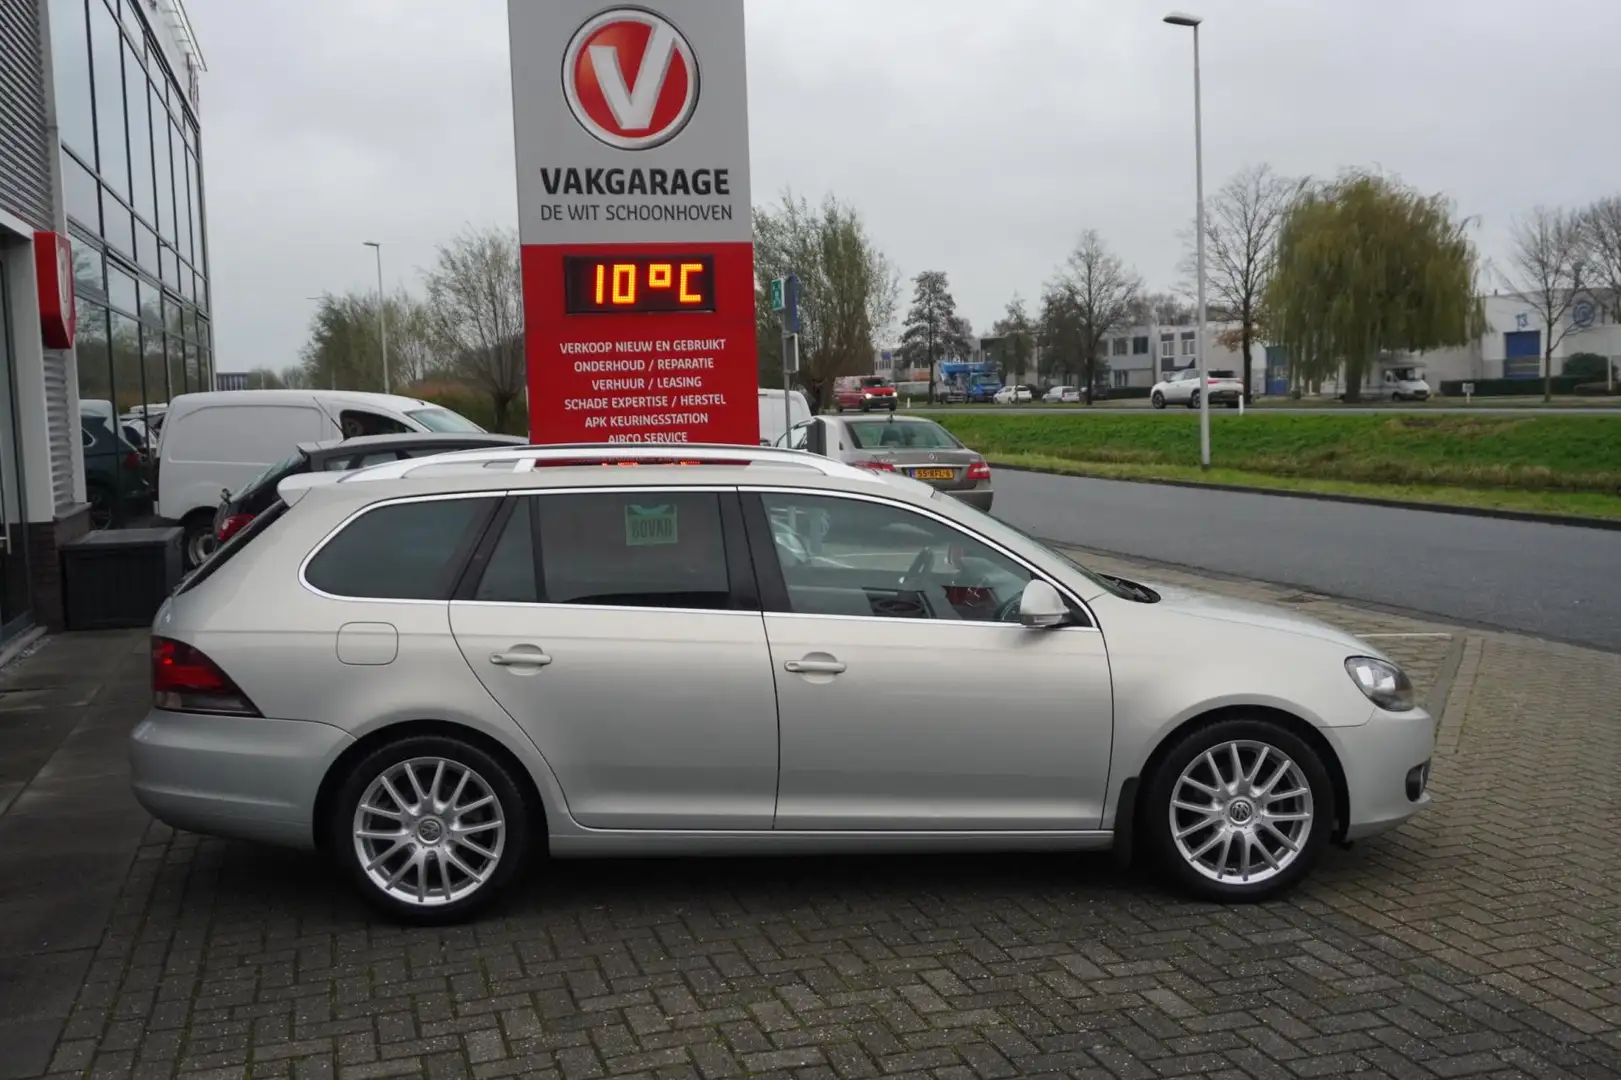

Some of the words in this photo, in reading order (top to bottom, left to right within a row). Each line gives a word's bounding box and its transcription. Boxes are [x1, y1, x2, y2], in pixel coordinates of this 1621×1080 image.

[540, 167, 730, 195] VAKGARAGE
[540, 204, 563, 221] DE
[568, 204, 600, 221] WIT
[605, 204, 732, 221] SCHOONHOVEN
[560, 341, 612, 354] VERKOOP
[616, 341, 653, 352] NIEUW
[656, 340, 670, 351] EN
[673, 339, 726, 351] GEBRUIKT
[574, 359, 645, 372] ONDERHOUD
[657, 358, 714, 370] REPARATIE
[592, 378, 645, 390] VERHUUR
[657, 376, 702, 388] LEASING
[564, 398, 608, 410] SCHADE
[612, 396, 668, 408] EXPERTISE
[681, 394, 726, 406] HERSTEL
[585, 416, 607, 428] APK
[610, 413, 708, 427] KEURINGSSTATION
[608, 434, 641, 444] AIRCO
[644, 431, 688, 444] SERVICE
